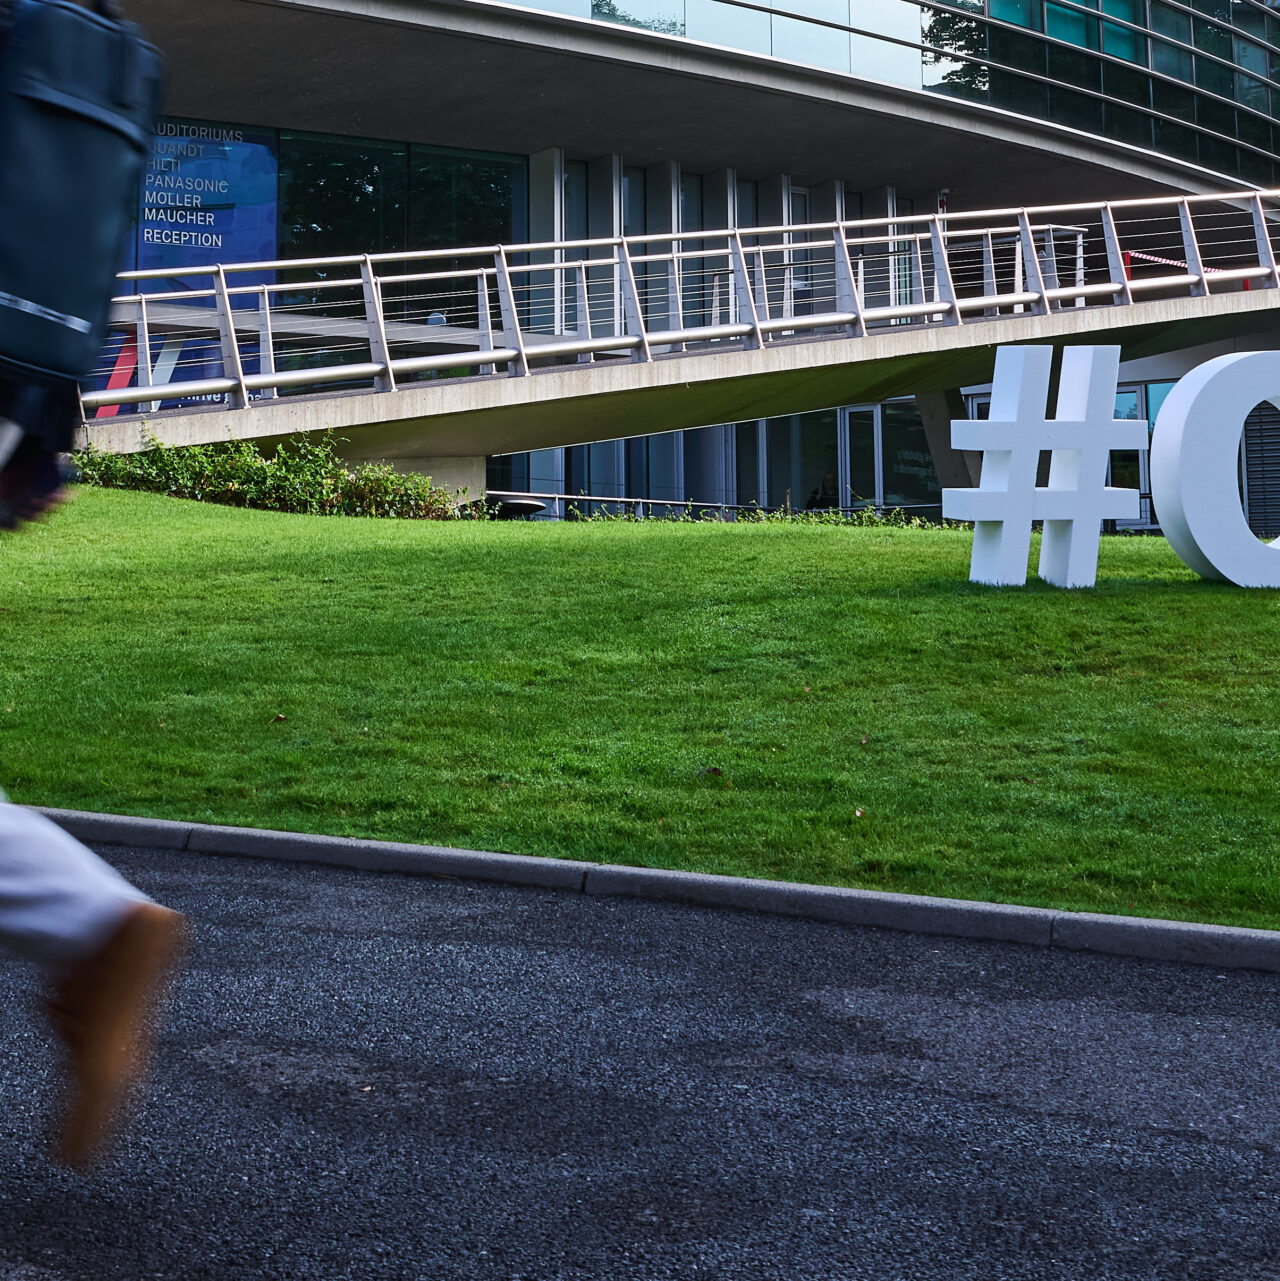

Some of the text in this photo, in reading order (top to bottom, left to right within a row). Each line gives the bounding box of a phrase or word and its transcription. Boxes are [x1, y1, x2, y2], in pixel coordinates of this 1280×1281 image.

[146, 157, 181, 173] HILTI
[145, 174, 229, 193] PANASONIC
[145, 191, 202, 208] MOLLER
[144, 208, 215, 226] MAUCHER
[144, 228, 222, 248] RECEPTION
